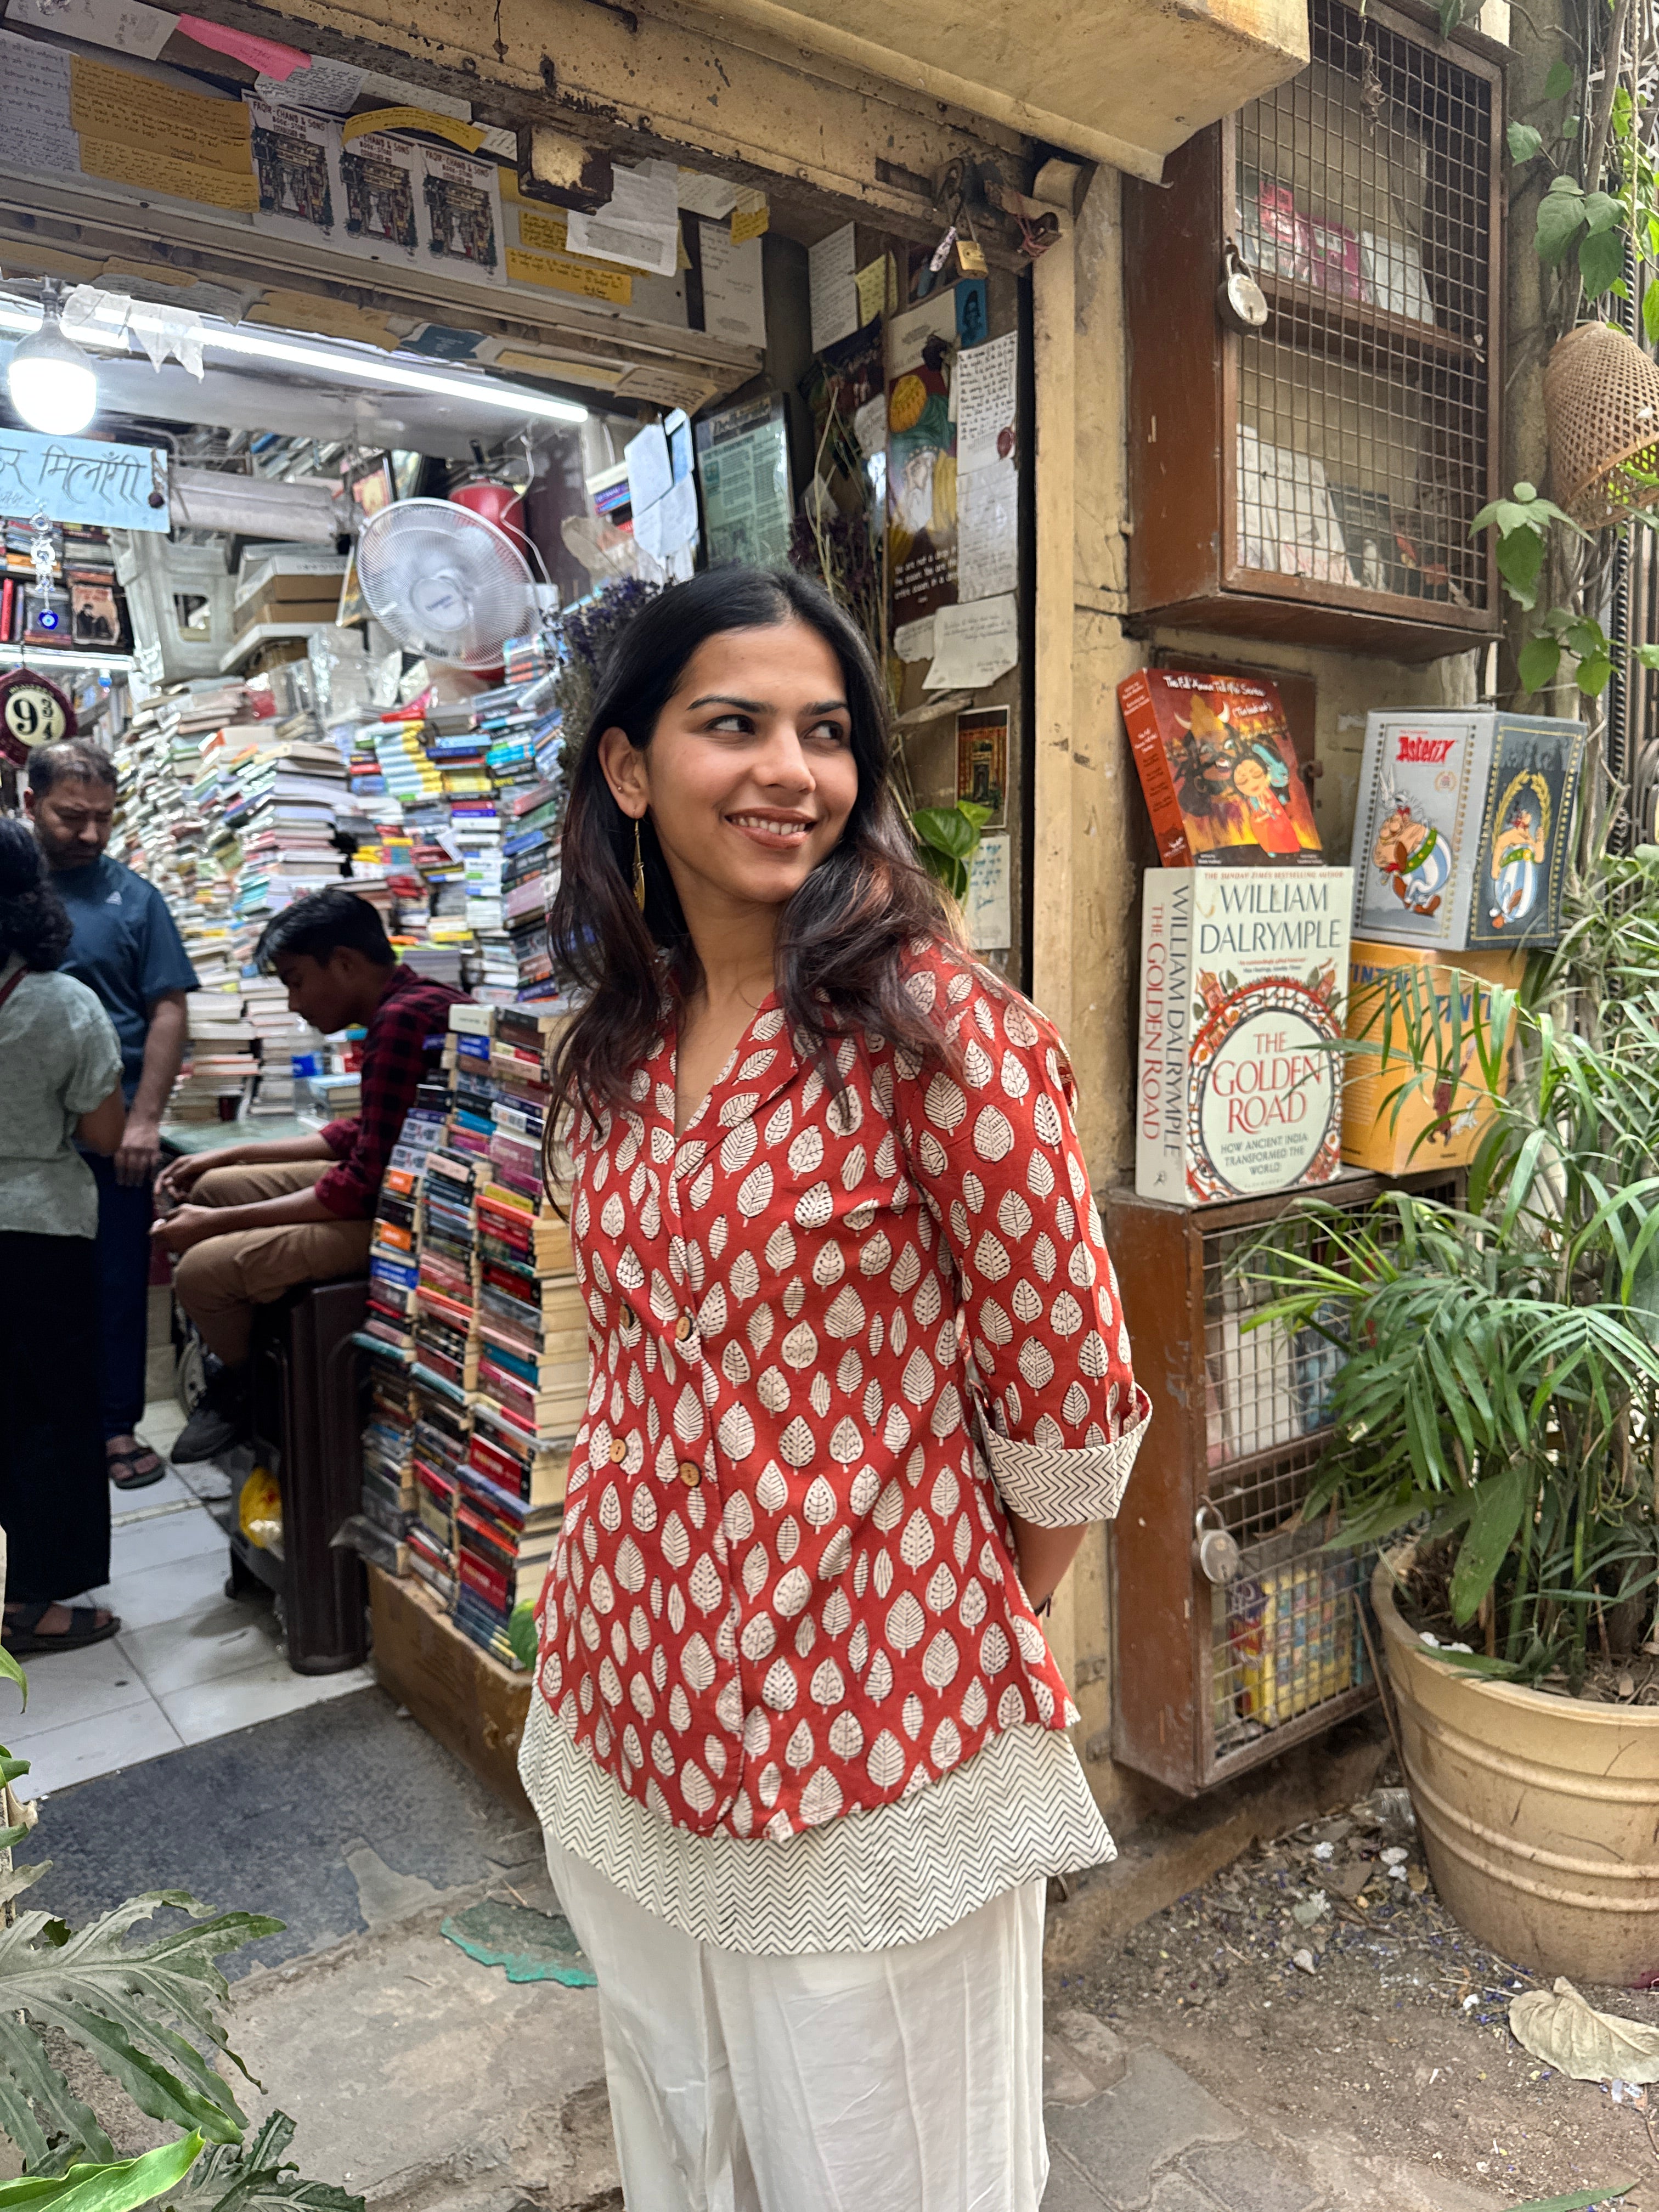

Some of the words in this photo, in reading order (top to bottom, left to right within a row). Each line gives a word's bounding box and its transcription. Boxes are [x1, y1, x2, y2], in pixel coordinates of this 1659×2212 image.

[308, 119, 325, 131] SONS
[13, 698, 38, 736] 9
[1221, 883, 1328, 914] WILLIAM
[1150, 903, 1163, 937] THE
[1200, 919, 1341, 954] DALRYMPLE
[1169, 885, 1189, 1005] WILLIAM
[1145, 942, 1166, 1054] GOLDEN
[1255, 1032, 1286, 1054] THE
[1164, 1011, 1186, 1158] DALRYMPLE
[1212, 1056, 1323, 1097] GOLDEN
[1142, 1059, 1163, 1140] ROAD
[1227, 1091, 1307, 1135] ROAD
[1221, 1142, 1242, 1154] HOW
[1245, 1135, 1283, 1150] ANCIENT
[1285, 1132, 1308, 1144] INDIA
[1224, 1148, 1286, 1167] TRANSFORMED
[1289, 1145, 1305, 1156] THE
[1249, 1161, 1280, 1175] WORLD
